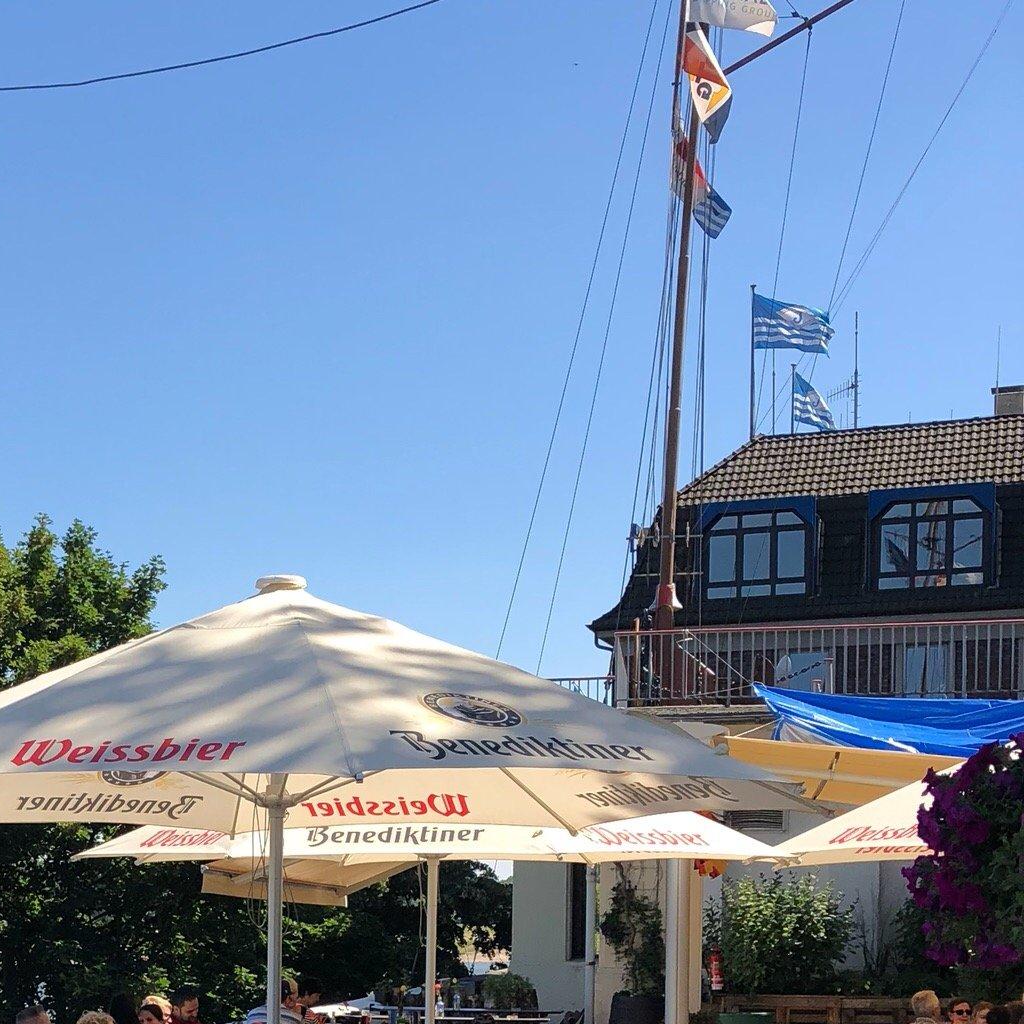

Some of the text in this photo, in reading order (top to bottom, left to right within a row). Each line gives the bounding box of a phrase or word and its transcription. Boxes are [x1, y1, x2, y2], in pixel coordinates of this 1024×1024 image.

[10, 738, 246, 767] Weissbier
[389, 730, 655, 760] Benediktiner
[139, 830, 227, 848] Weissbier
[306, 826, 485, 847] Benediktiner
[584, 826, 710, 846] Weissbier
